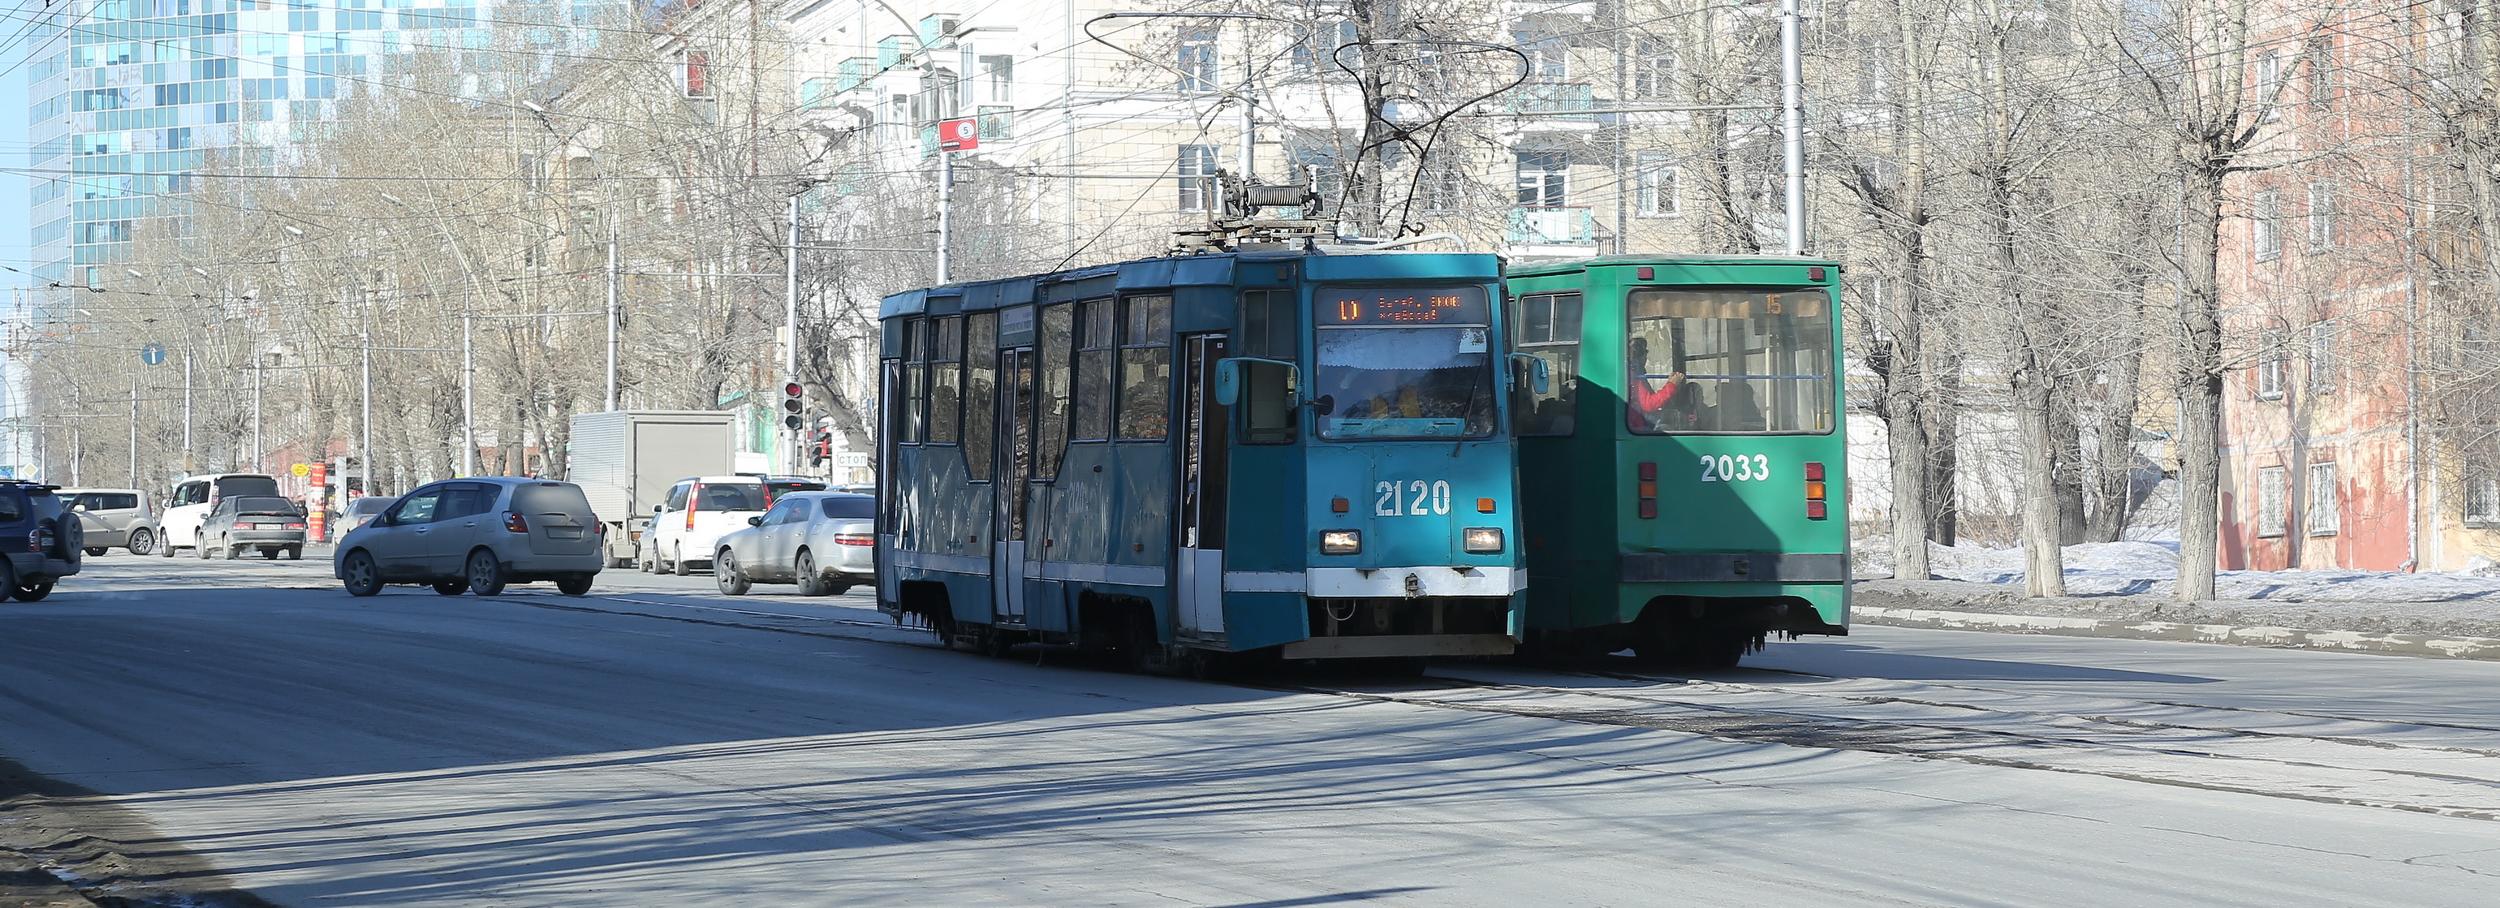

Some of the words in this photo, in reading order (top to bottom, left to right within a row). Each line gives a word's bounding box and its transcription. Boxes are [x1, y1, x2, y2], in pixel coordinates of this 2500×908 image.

[1766, 293, 1782, 314] 15
[839, 455, 867, 464] СТОП
[1700, 453, 1770, 482] 2033
[1375, 479, 1450, 516] 2120
